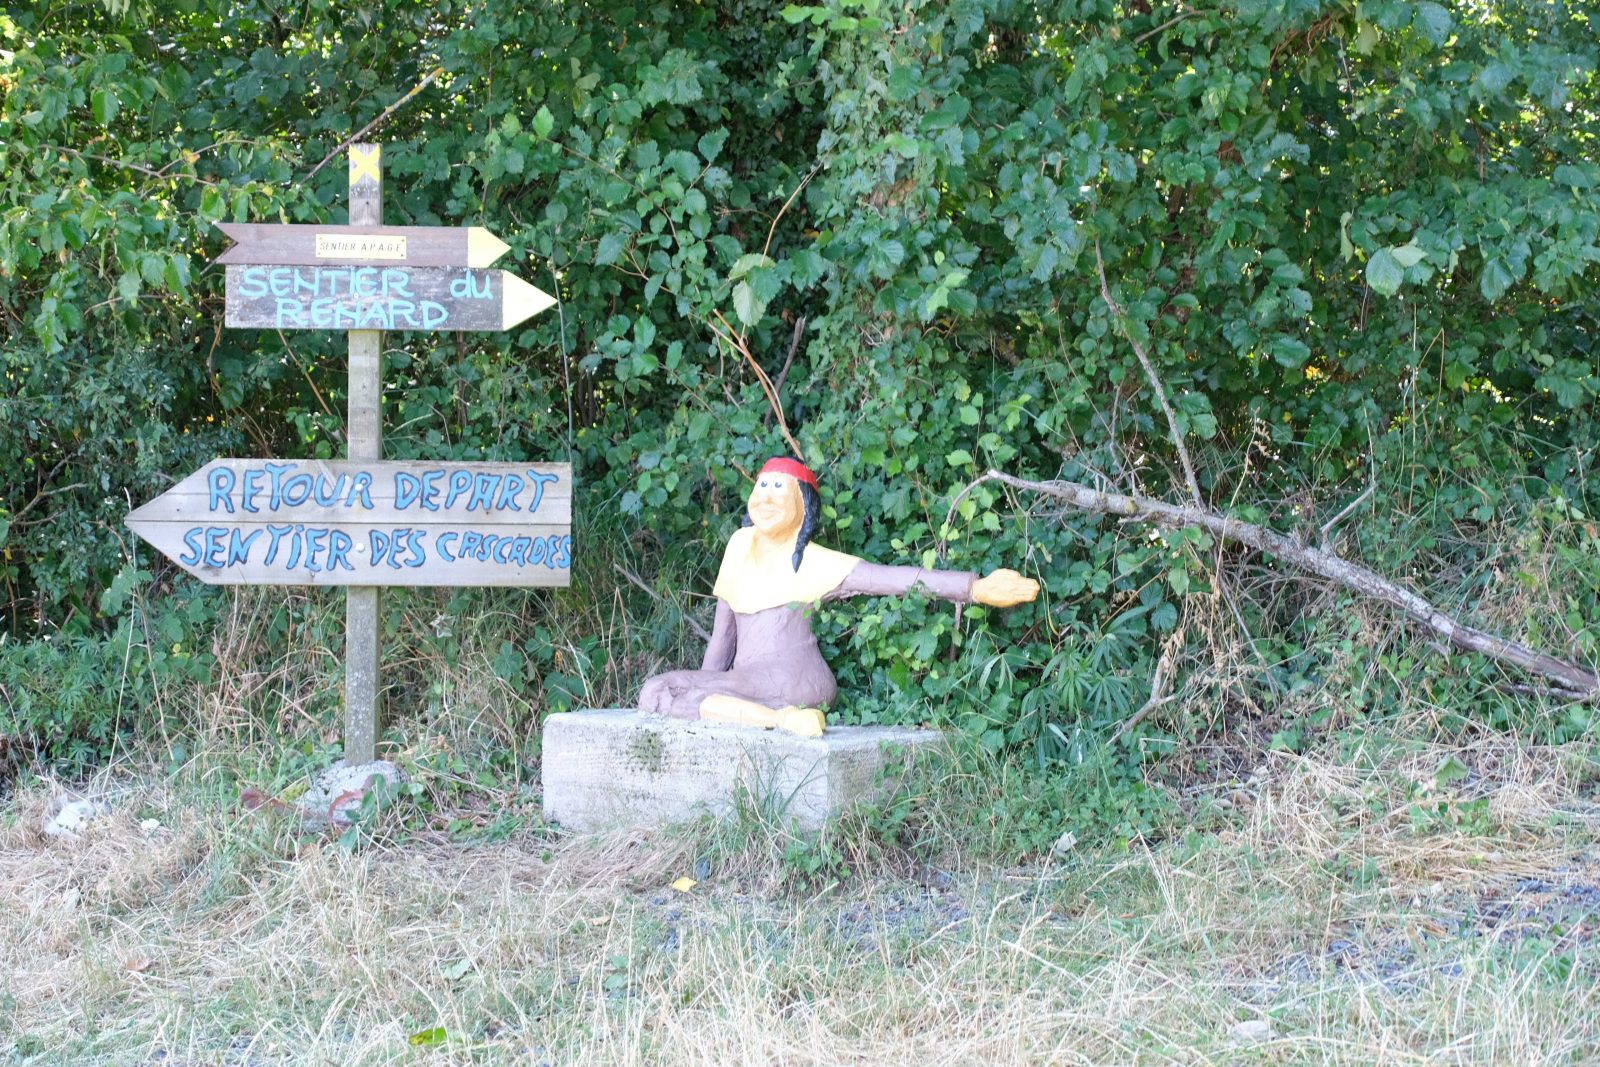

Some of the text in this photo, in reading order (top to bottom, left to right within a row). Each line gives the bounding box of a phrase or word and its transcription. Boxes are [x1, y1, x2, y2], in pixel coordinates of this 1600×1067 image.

[320, 241, 356, 252] SENTIER
[239, 267, 494, 300] SENTIER du
[275, 297, 449, 329] RENARD
[208, 463, 559, 513] RETOUR DEPART
[179, 524, 571, 572] SENTIER DES CASCADES
